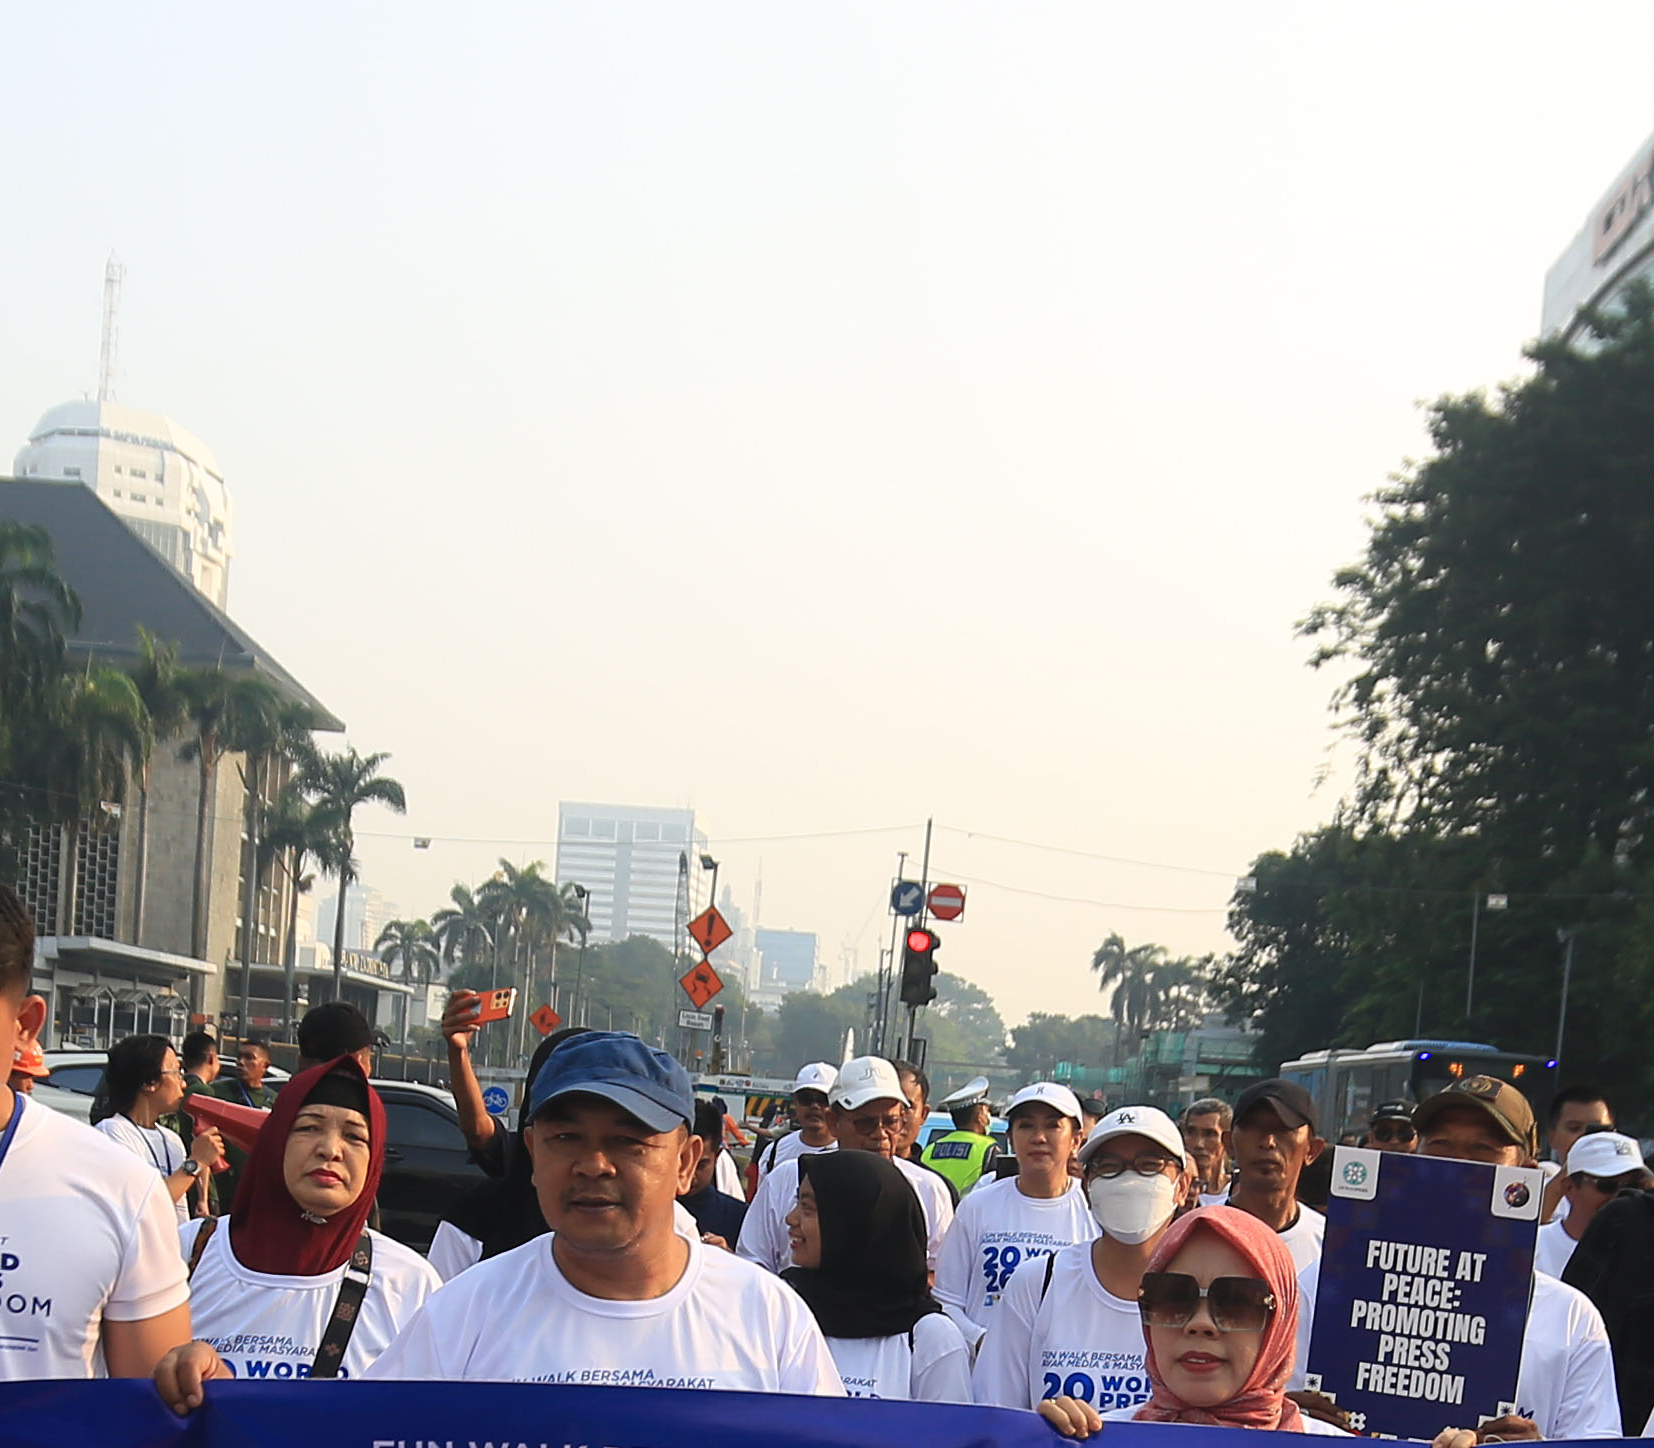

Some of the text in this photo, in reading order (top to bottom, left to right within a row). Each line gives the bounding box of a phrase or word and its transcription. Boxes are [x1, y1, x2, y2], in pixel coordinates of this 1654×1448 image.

[935, 1142, 969, 1159] POLISI
[983, 1245, 1021, 1271] 20
[1366, 1239, 1487, 1283] FUTURE AT
[1381, 1272, 1461, 1309] PEACE:
[1350, 1299, 1487, 1345] PROMOTING
[216, 1343, 245, 1354] EDIA
[260, 1345, 317, 1357] MASYARA
[234, 1334, 294, 1347] BERSAMA
[1058, 1351, 1090, 1360] WALK
[1091, 1352, 1143, 1363] BERSAMA
[1377, 1334, 1451, 1372] PRESS
[245, 1359, 350, 1379] WORD
[581, 1368, 655, 1382] BERSAMA
[1066, 1359, 1099, 1368] MEDIA
[1102, 1361, 1111, 1370] &
[1112, 1361, 1147, 1371] MASYA
[1355, 1361, 1465, 1405] FREEDOM
